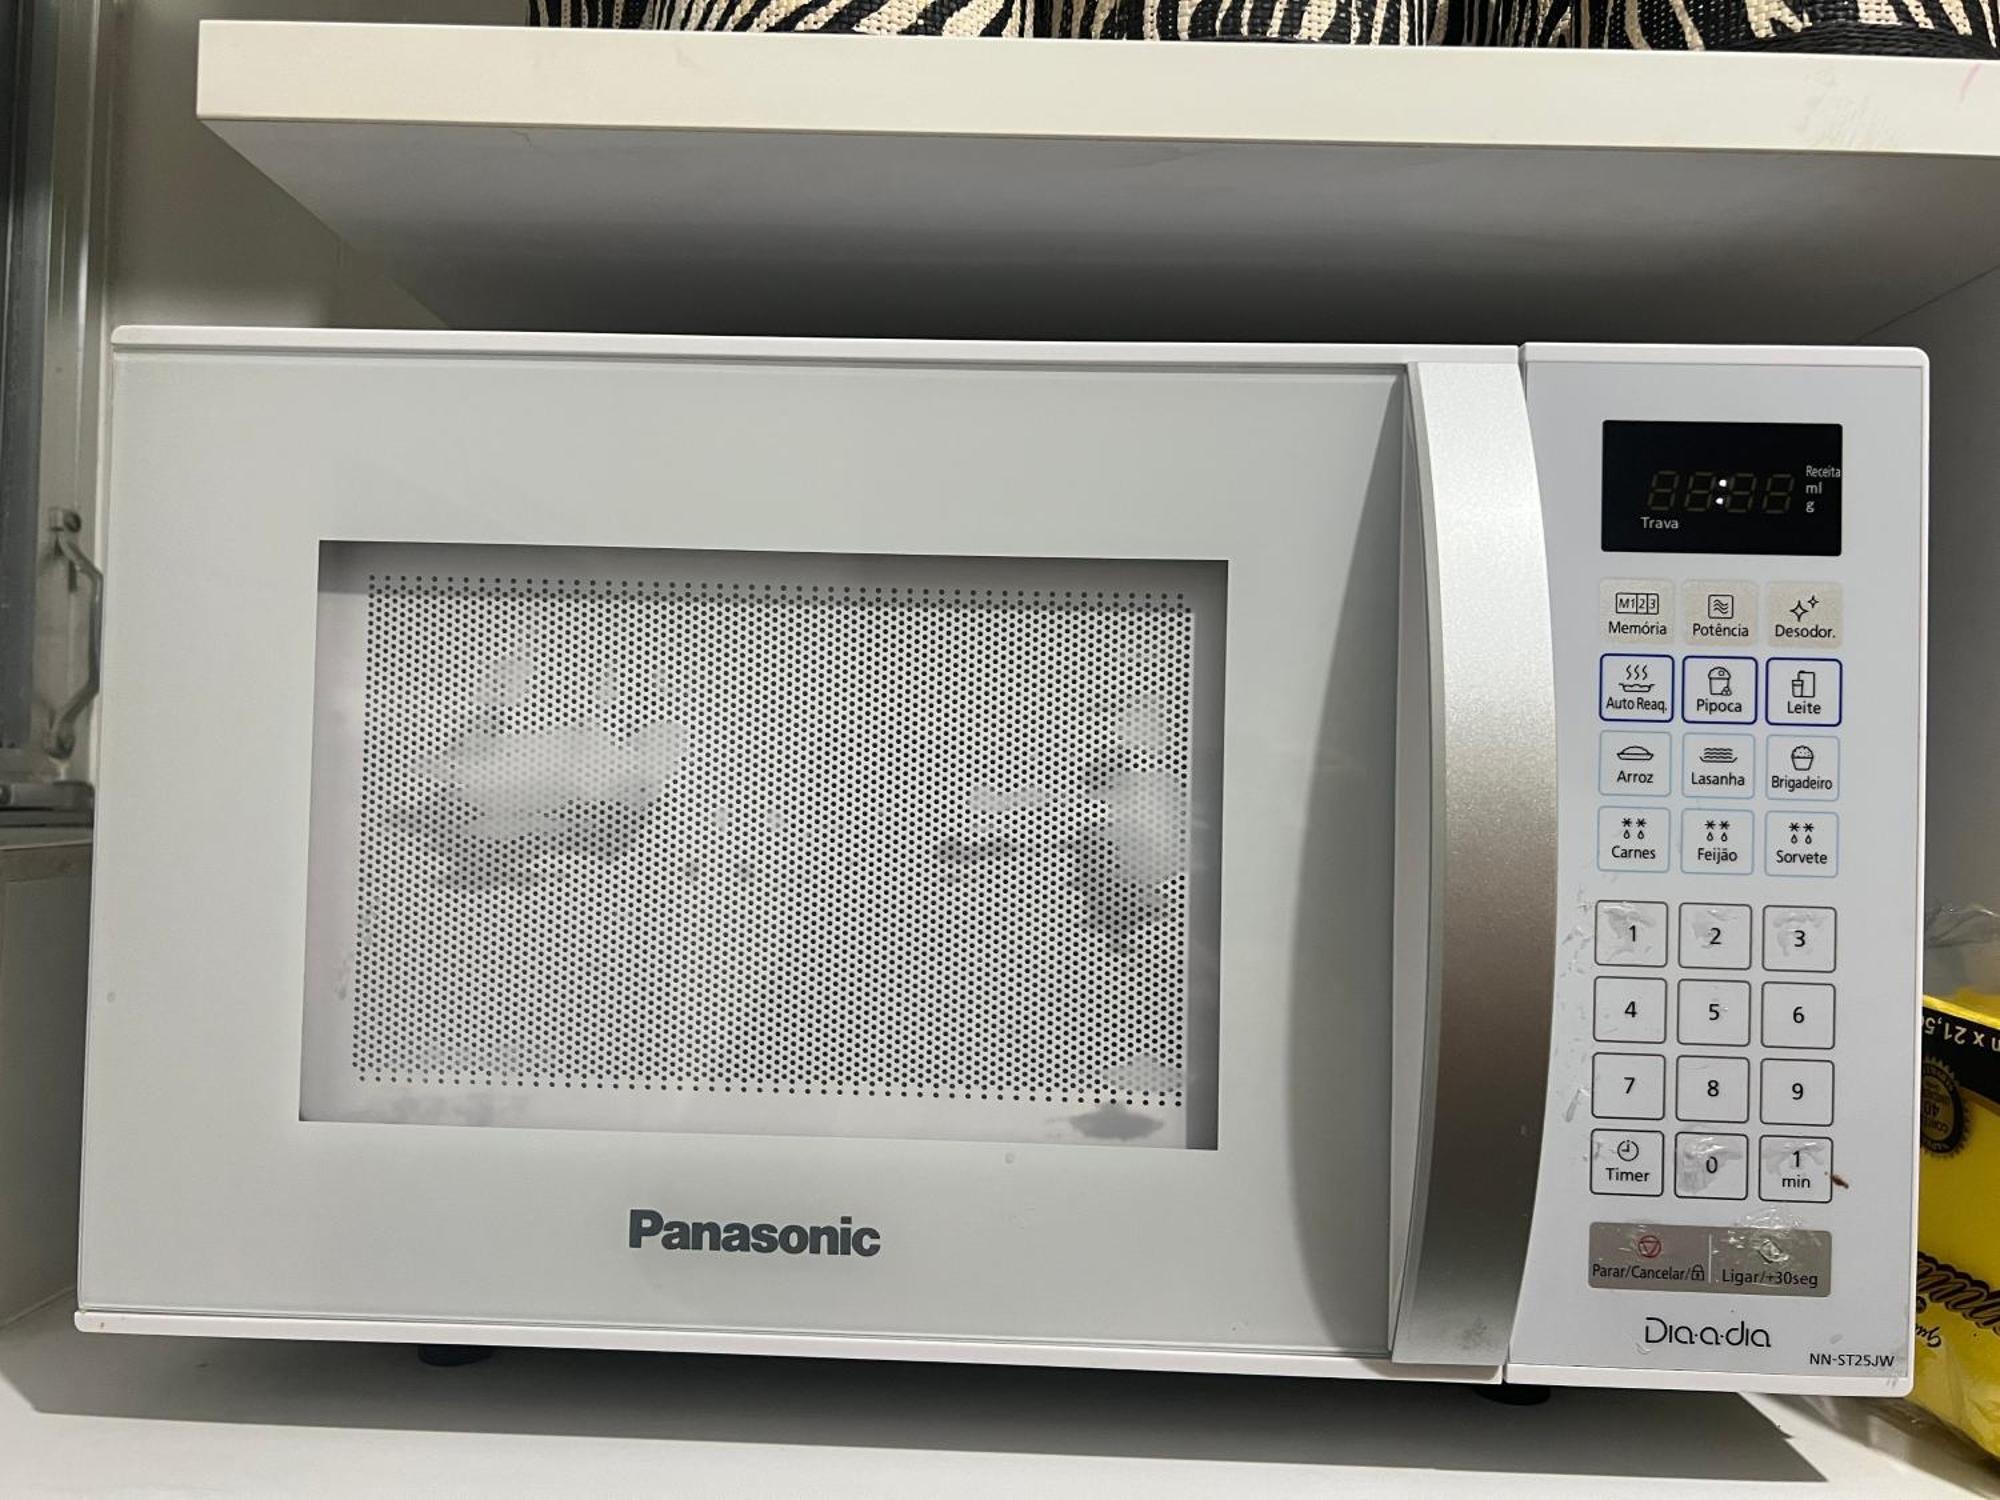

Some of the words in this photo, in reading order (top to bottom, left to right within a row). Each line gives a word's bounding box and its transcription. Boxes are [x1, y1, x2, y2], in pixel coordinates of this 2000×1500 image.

[1805, 465, 1841, 478] Receita
[1805, 481, 1823, 494] ml
[1805, 501, 1815, 513] g
[1640, 516, 1679, 529] Trava
[1608, 620, 1667, 636] Memória
[1692, 622, 1749, 637] Potência
[1775, 624, 1836, 639] Desodor.
[1605, 697, 1635, 710] Auto
[1636, 698, 1668, 713] Reaq.
[1696, 698, 1742, 715] Pipoca
[1787, 700, 1822, 715] Leite
[1616, 770, 1654, 784] Arroz
[1691, 771, 1745, 786] Lasanha
[1771, 775, 1833, 792] Brigadeiro
[1611, 845, 1656, 860] Carnes
[1697, 848, 1738, 864] Feijão
[1776, 849, 1828, 865] Sorvete
[1628, 925, 1636, 942] 1
[1709, 927, 1722, 945] 2
[1794, 930, 1806, 947] 3
[1624, 1000, 1637, 1018] 4
[1709, 1003, 1720, 1021] 5
[1793, 1006, 1805, 1023] 6
[1921, 1016, 1968, 1045] 21,5
[1623, 1077, 1636, 1094] 7
[1707, 1079, 1720, 1097] 8
[1791, 1082, 1804, 1100] 9
[1705, 1155, 1718, 1174] 0
[1792, 1150, 1801, 1168] 1
[1605, 1167, 1650, 1182] Timer
[1782, 1175, 1811, 1188] min
[628, 1208, 881, 1257] Panasonic
[1809, 1353, 1895, 1367] NN-ST25JW
